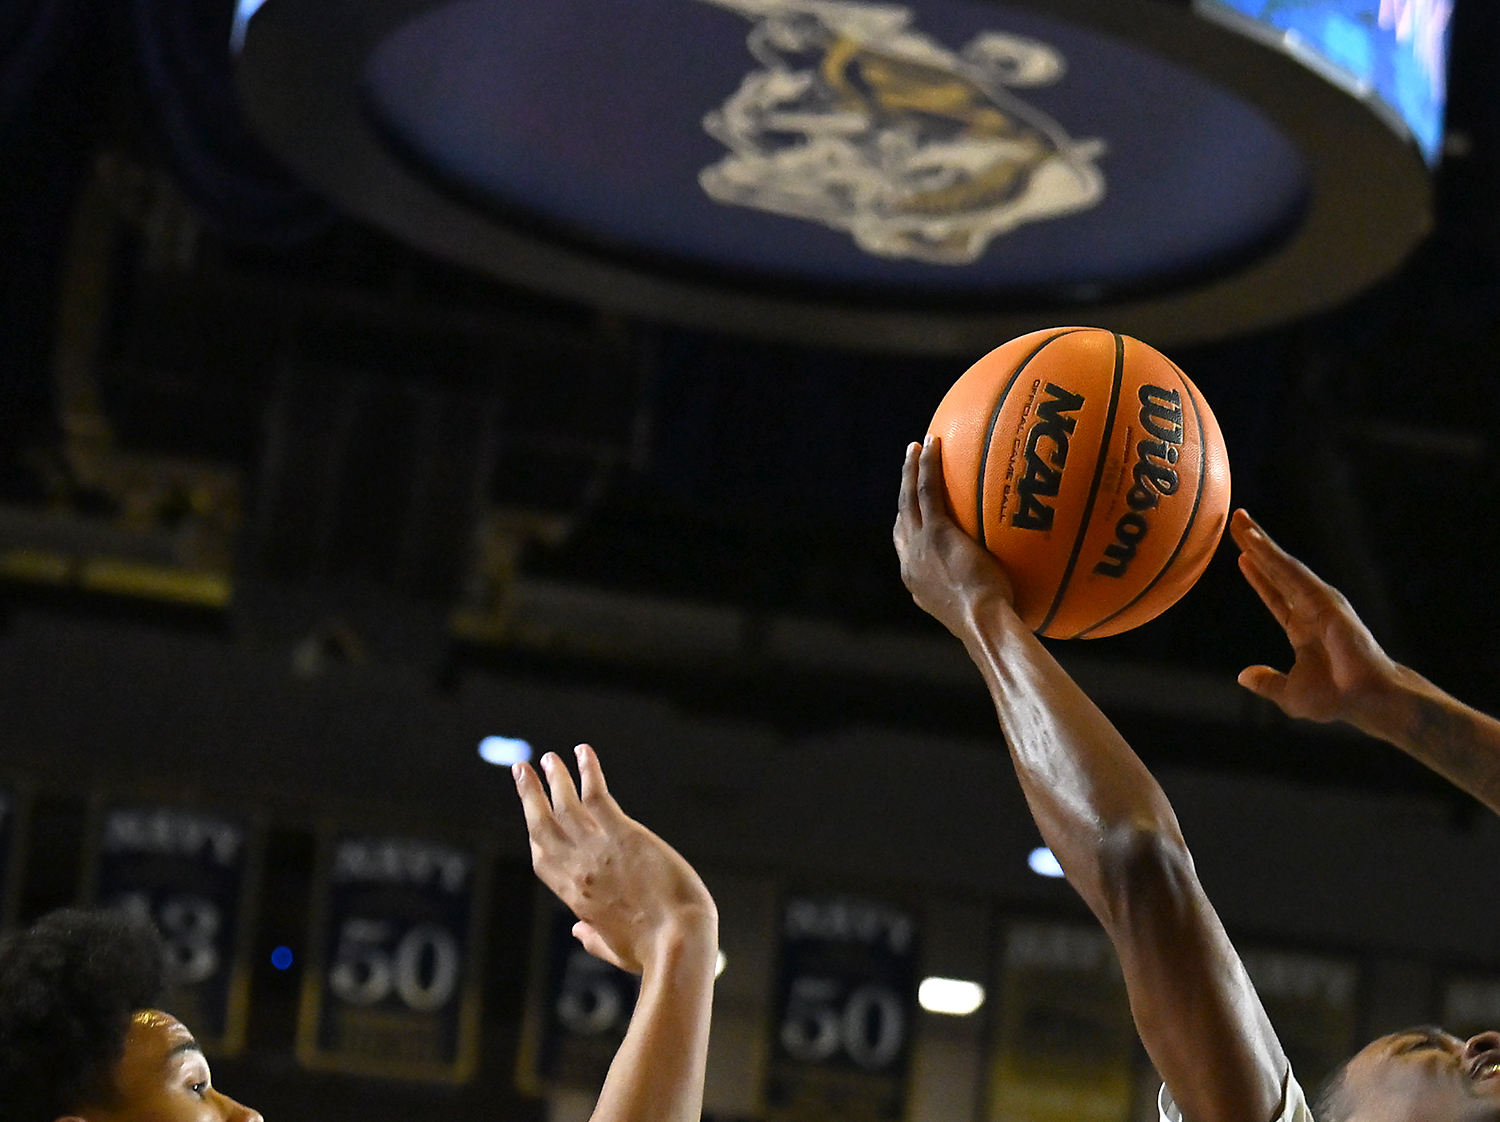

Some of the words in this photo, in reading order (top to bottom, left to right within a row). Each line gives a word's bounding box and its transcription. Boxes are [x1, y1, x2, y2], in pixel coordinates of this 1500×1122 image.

[1010, 381, 1086, 531] NCAA
[1092, 384, 1184, 579] Wilson
[328, 915, 460, 1012] 50
[780, 975, 905, 1070] 50
